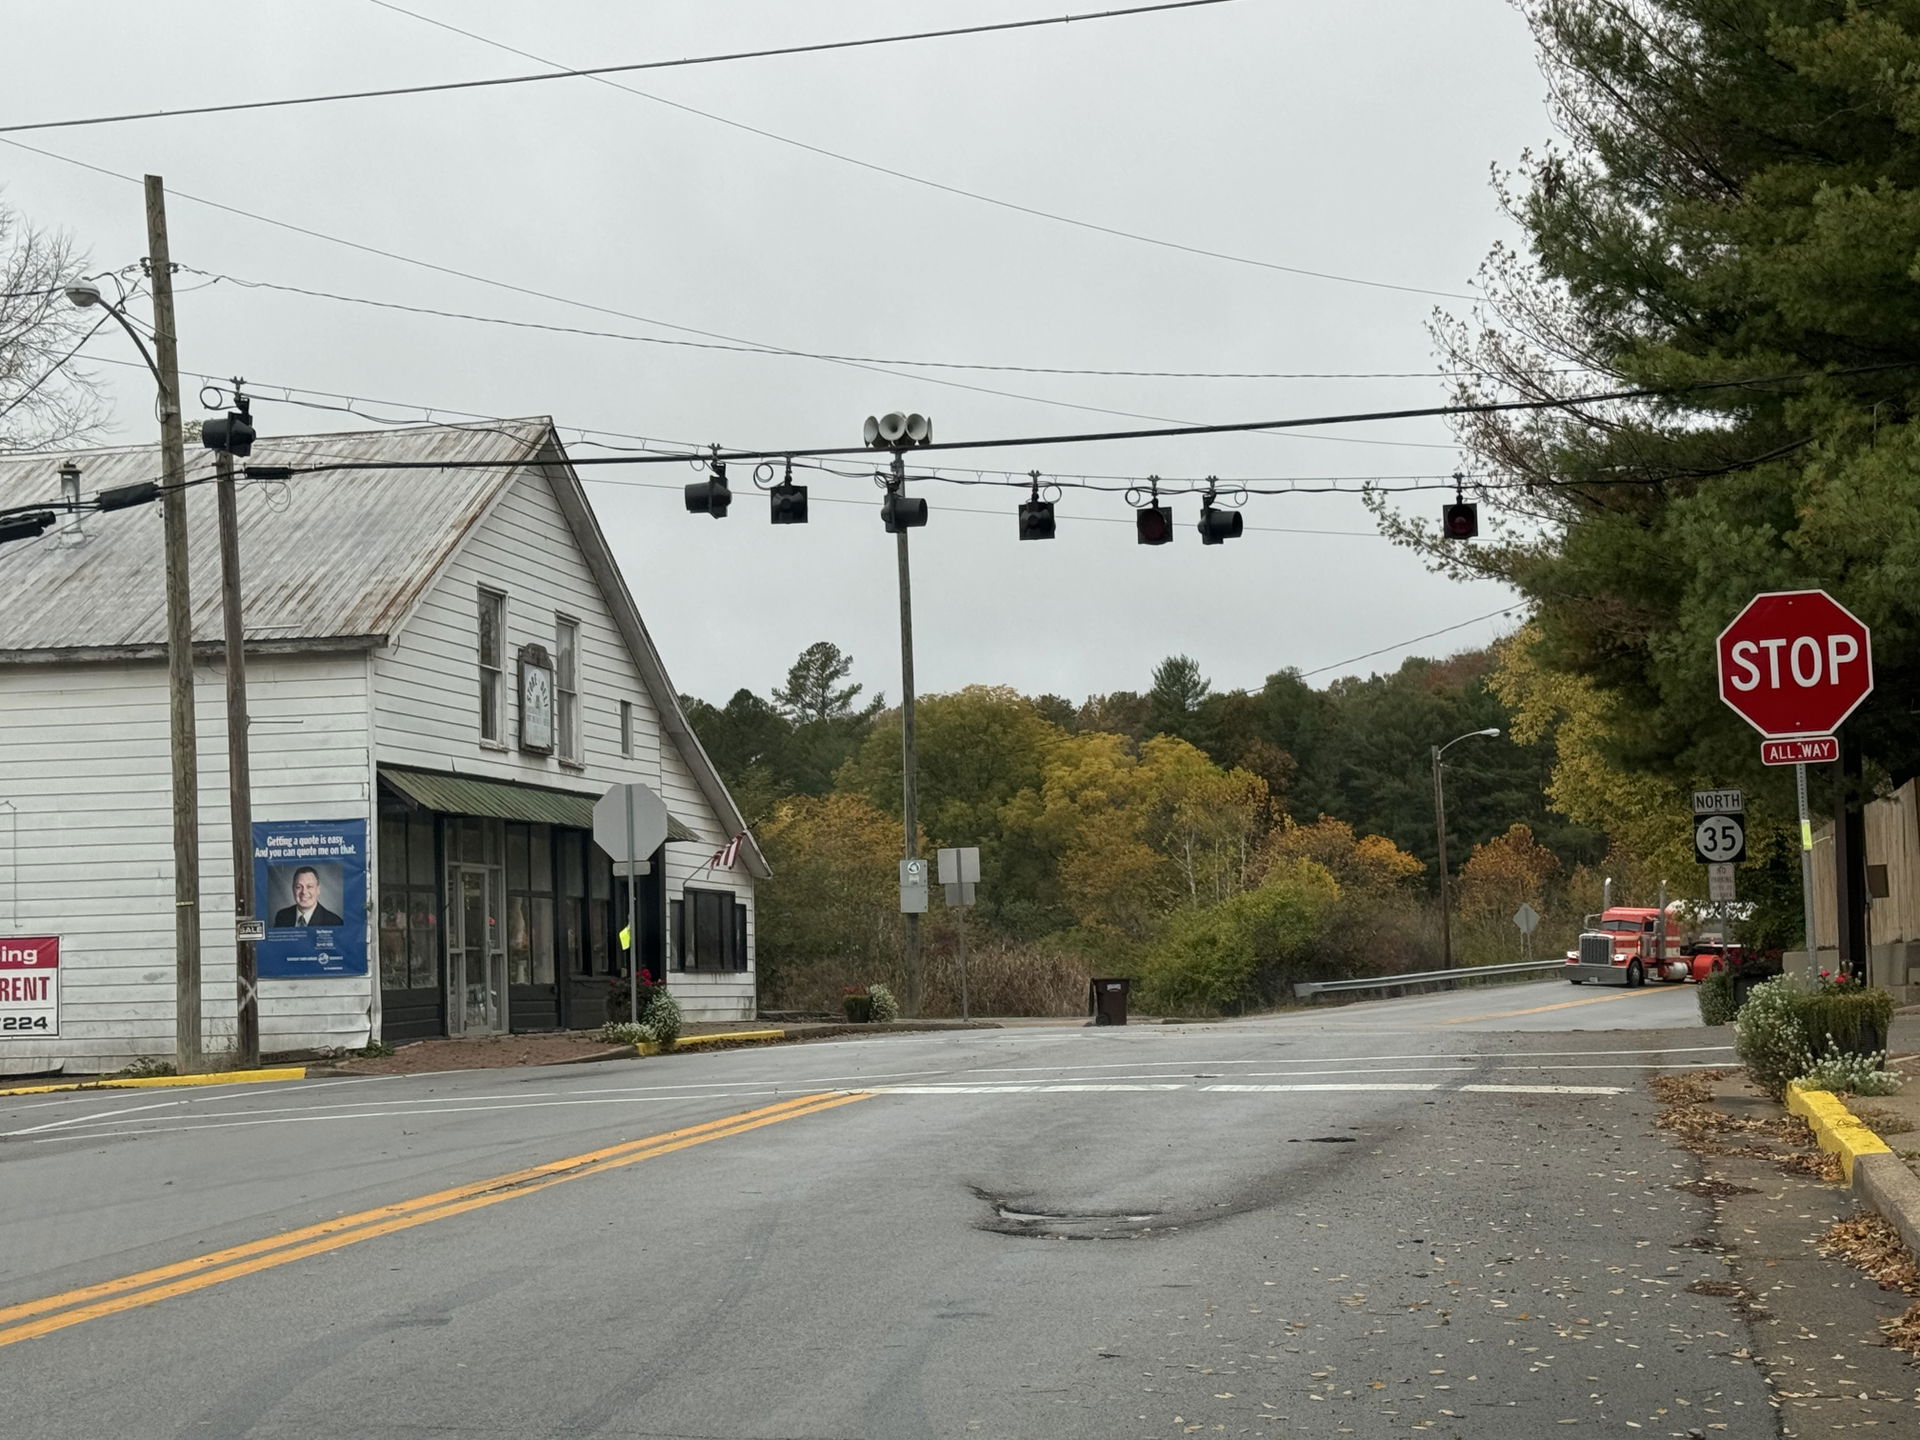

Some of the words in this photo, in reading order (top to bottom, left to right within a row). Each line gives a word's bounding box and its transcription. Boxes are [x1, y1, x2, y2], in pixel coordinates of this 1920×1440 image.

[1730, 634, 1859, 692] STOP
[1769, 744, 1795, 761] ALL
[1800, 742, 1831, 758] WAY
[1695, 793, 1740, 809] NORTH
[267, 836, 293, 847] Getting
[293, 838, 298, 846] a
[299, 835, 319, 847] quote
[320, 835, 327, 844] is
[327, 836, 345, 846] easy.
[1703, 825, 1736, 853] 35
[254, 848, 268, 858] And
[268, 849, 282, 860] you
[283, 849, 296, 857] can
[297, 847, 317, 858] quote
[330, 847, 340, 855] on
[340, 845, 356, 854] that.
[240, 926, 262, 934] SALE
[0, 946, 38, 965] ing
[0, 976, 50, 1002] RENT
[0, 1016, 48, 1031] 224
